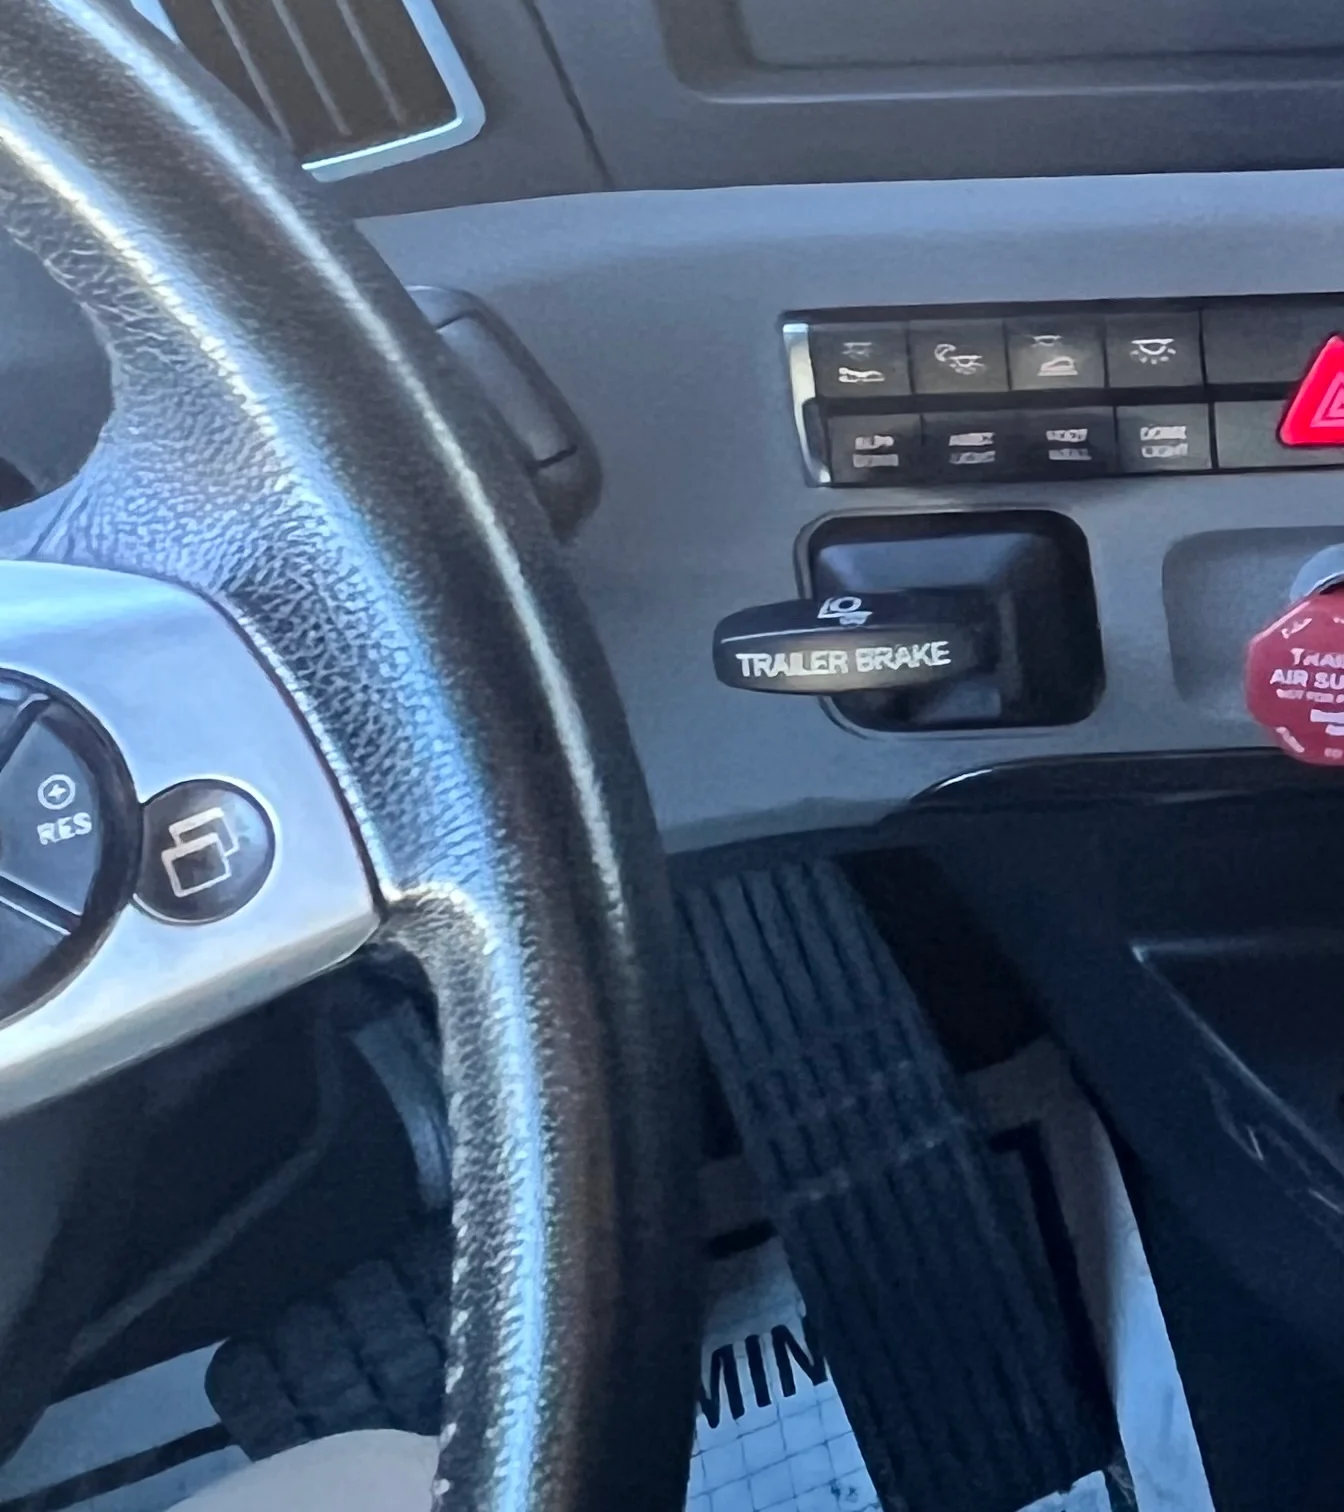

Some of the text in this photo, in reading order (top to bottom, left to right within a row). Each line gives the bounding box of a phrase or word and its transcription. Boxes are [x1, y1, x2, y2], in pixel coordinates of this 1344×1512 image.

[735, 640, 952, 678] TRAILER BRAKE
[1269, 668, 1309, 688] AIR
[36, 812, 93, 846] RES
